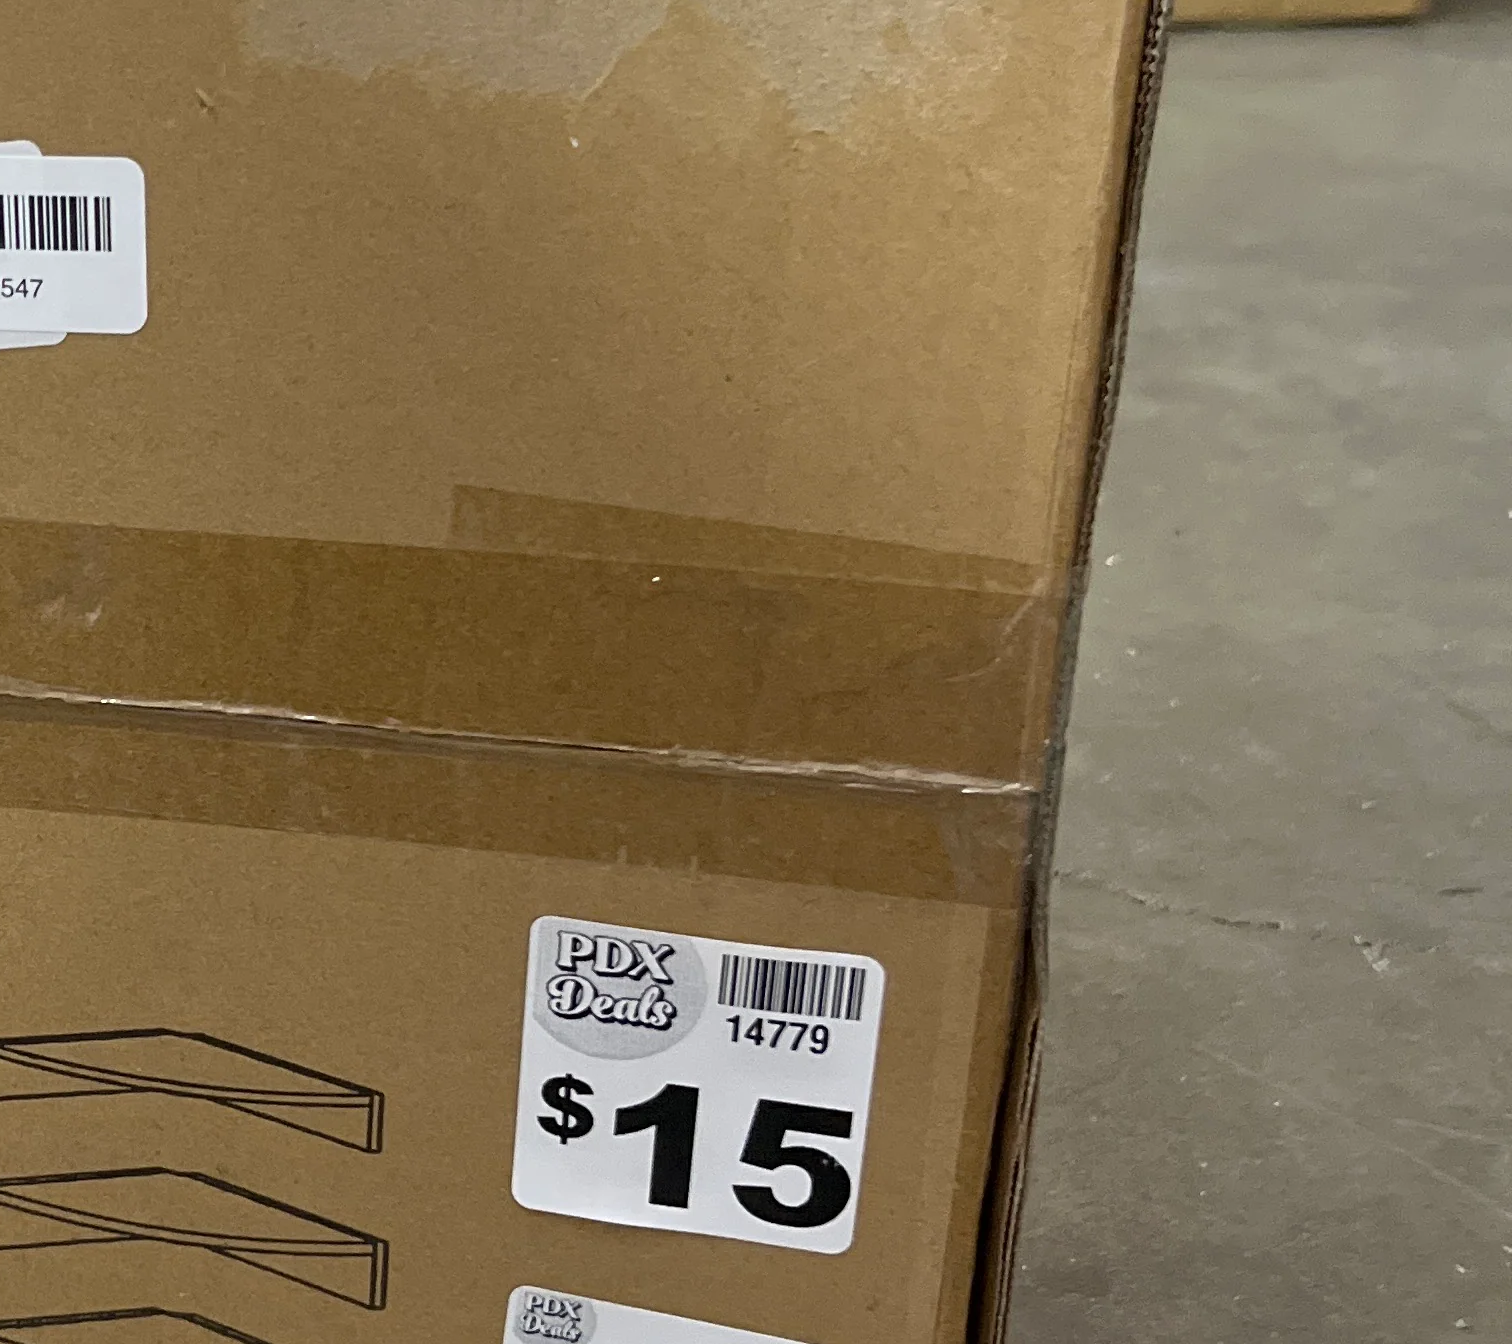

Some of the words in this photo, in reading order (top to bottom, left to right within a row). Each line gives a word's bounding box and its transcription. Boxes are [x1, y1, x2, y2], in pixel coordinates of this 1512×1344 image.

[556, 930, 676, 985] PDX
[546, 973, 678, 1031] Deals
[726, 1015, 829, 1054] 14779
[524, 1291, 582, 1322] PDX
[519, 1313, 583, 1343] Deals
